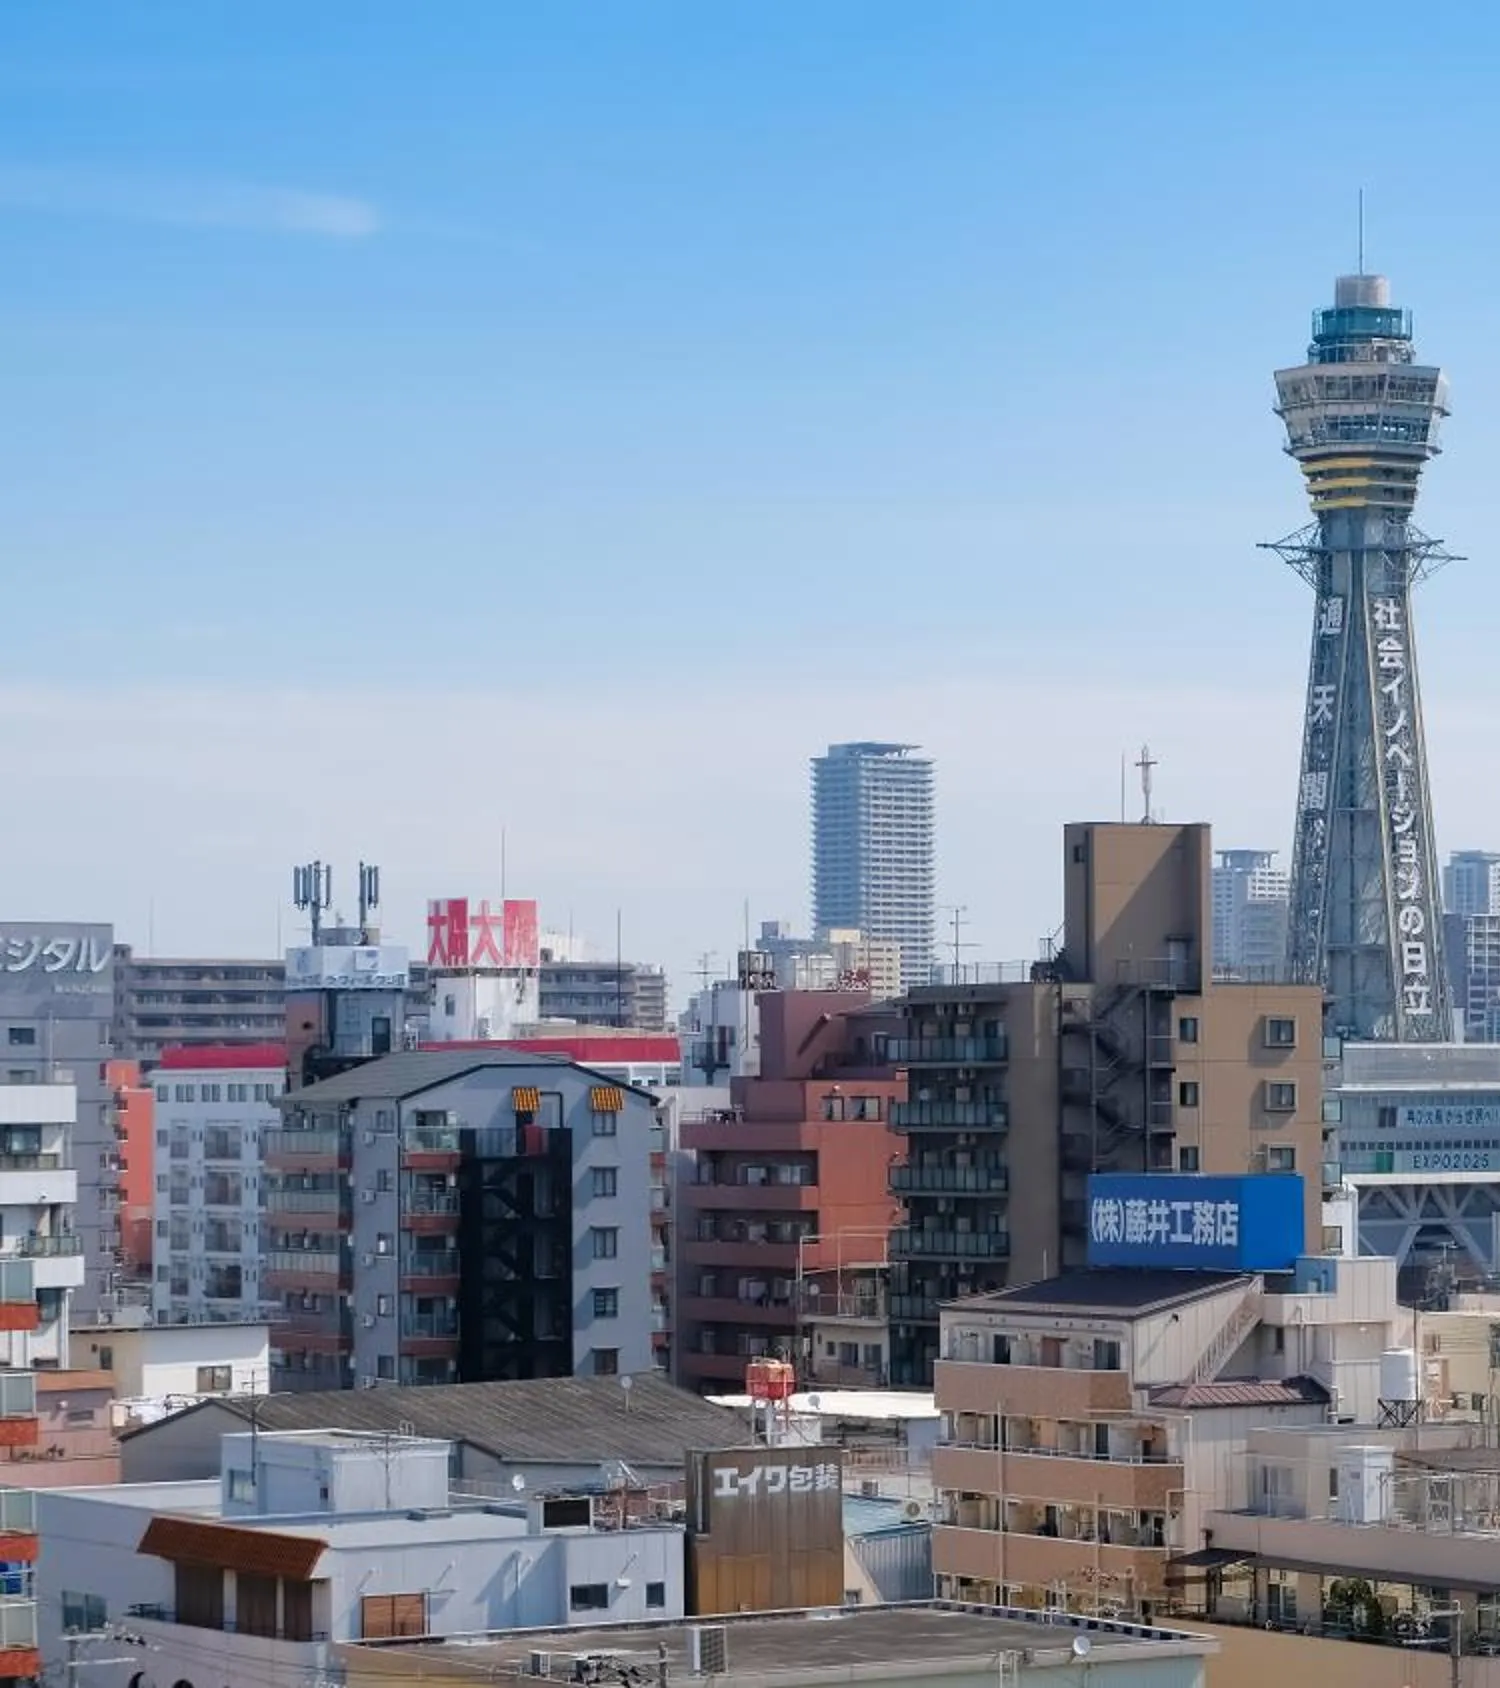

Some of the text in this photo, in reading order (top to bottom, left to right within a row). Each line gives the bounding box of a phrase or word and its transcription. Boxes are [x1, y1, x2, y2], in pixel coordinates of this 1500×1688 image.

[1301, 597, 1343, 811] 通天閣
[1374, 597, 1432, 1015] 社会イノベーションの日立
[0, 937, 112, 973] ジタル
[1413, 1153, 1489, 1169] EXPO2025
[1091, 1198, 1239, 1246] (株)藤井工務店
[713, 1463, 840, 1496] エイワ包装
